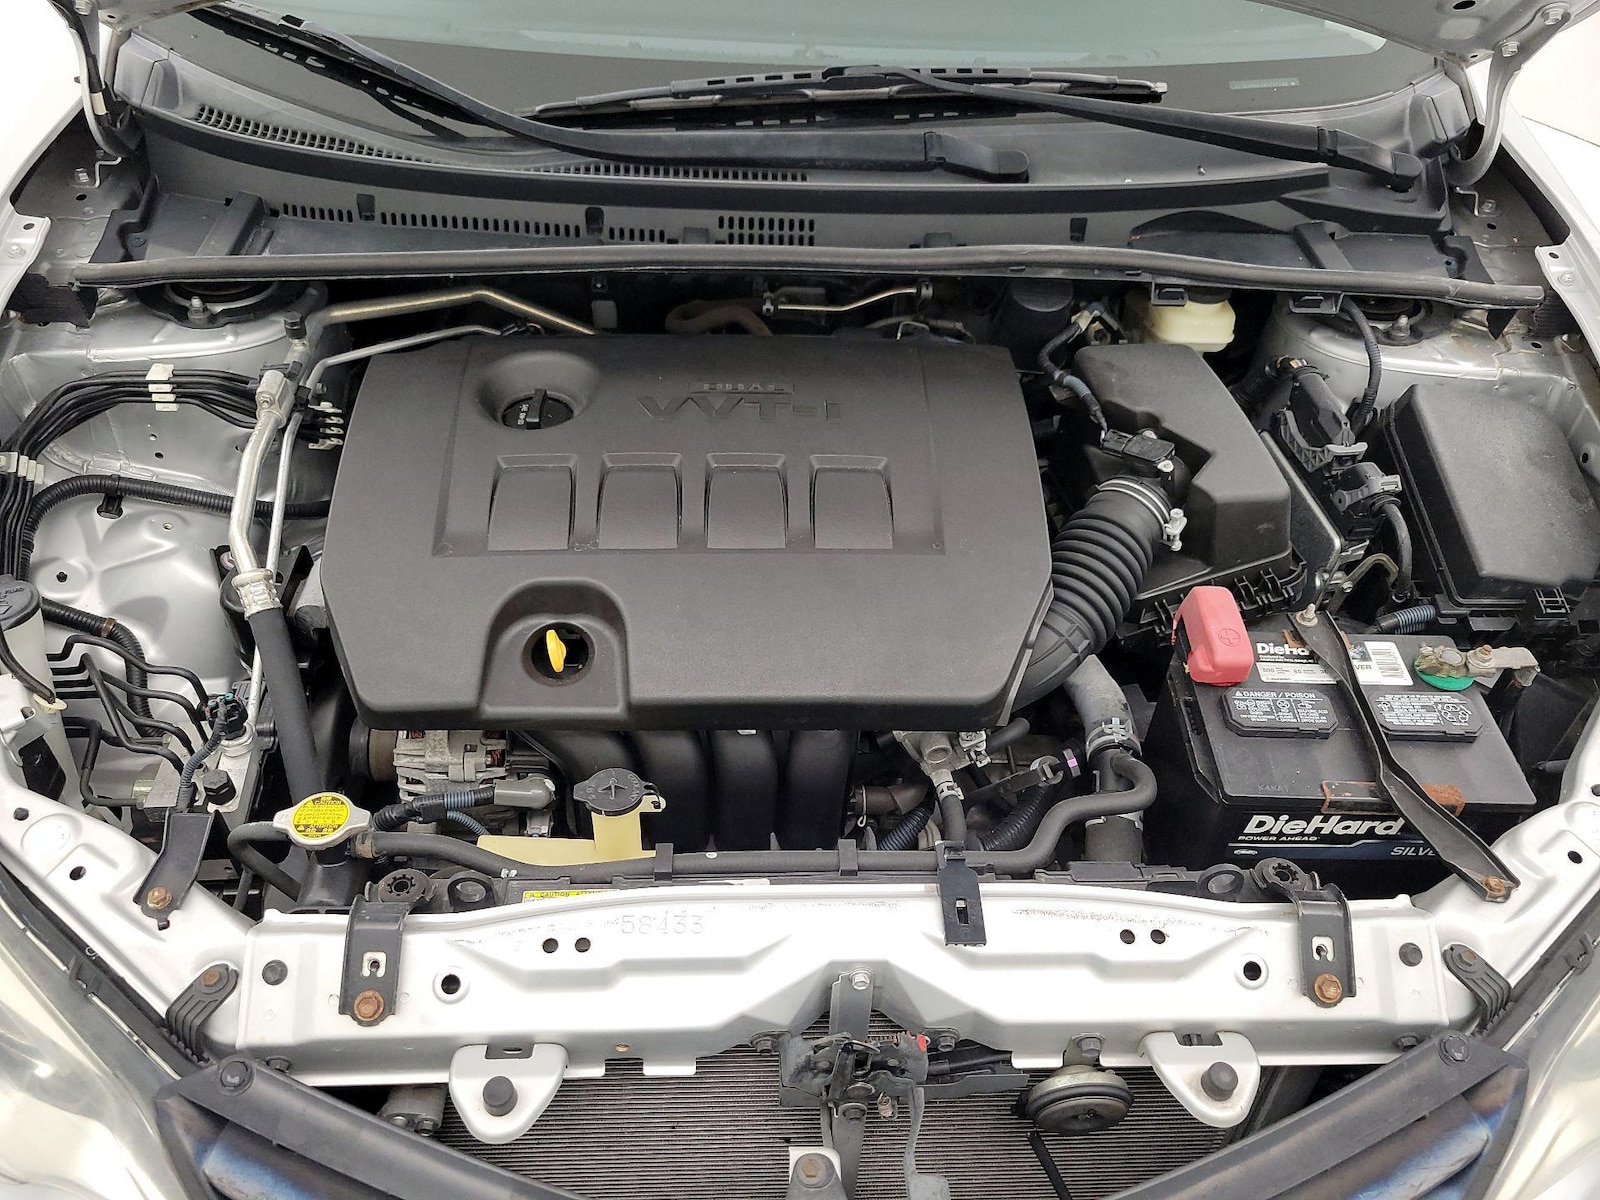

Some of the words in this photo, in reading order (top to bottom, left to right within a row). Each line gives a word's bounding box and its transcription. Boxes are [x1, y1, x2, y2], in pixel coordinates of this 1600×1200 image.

[703, 383, 785, 392] DUAL
[1256, 642, 1310, 656] DieHa
[1243, 815, 1406, 835] DieHard
[1390, 846, 1436, 856] SILV
